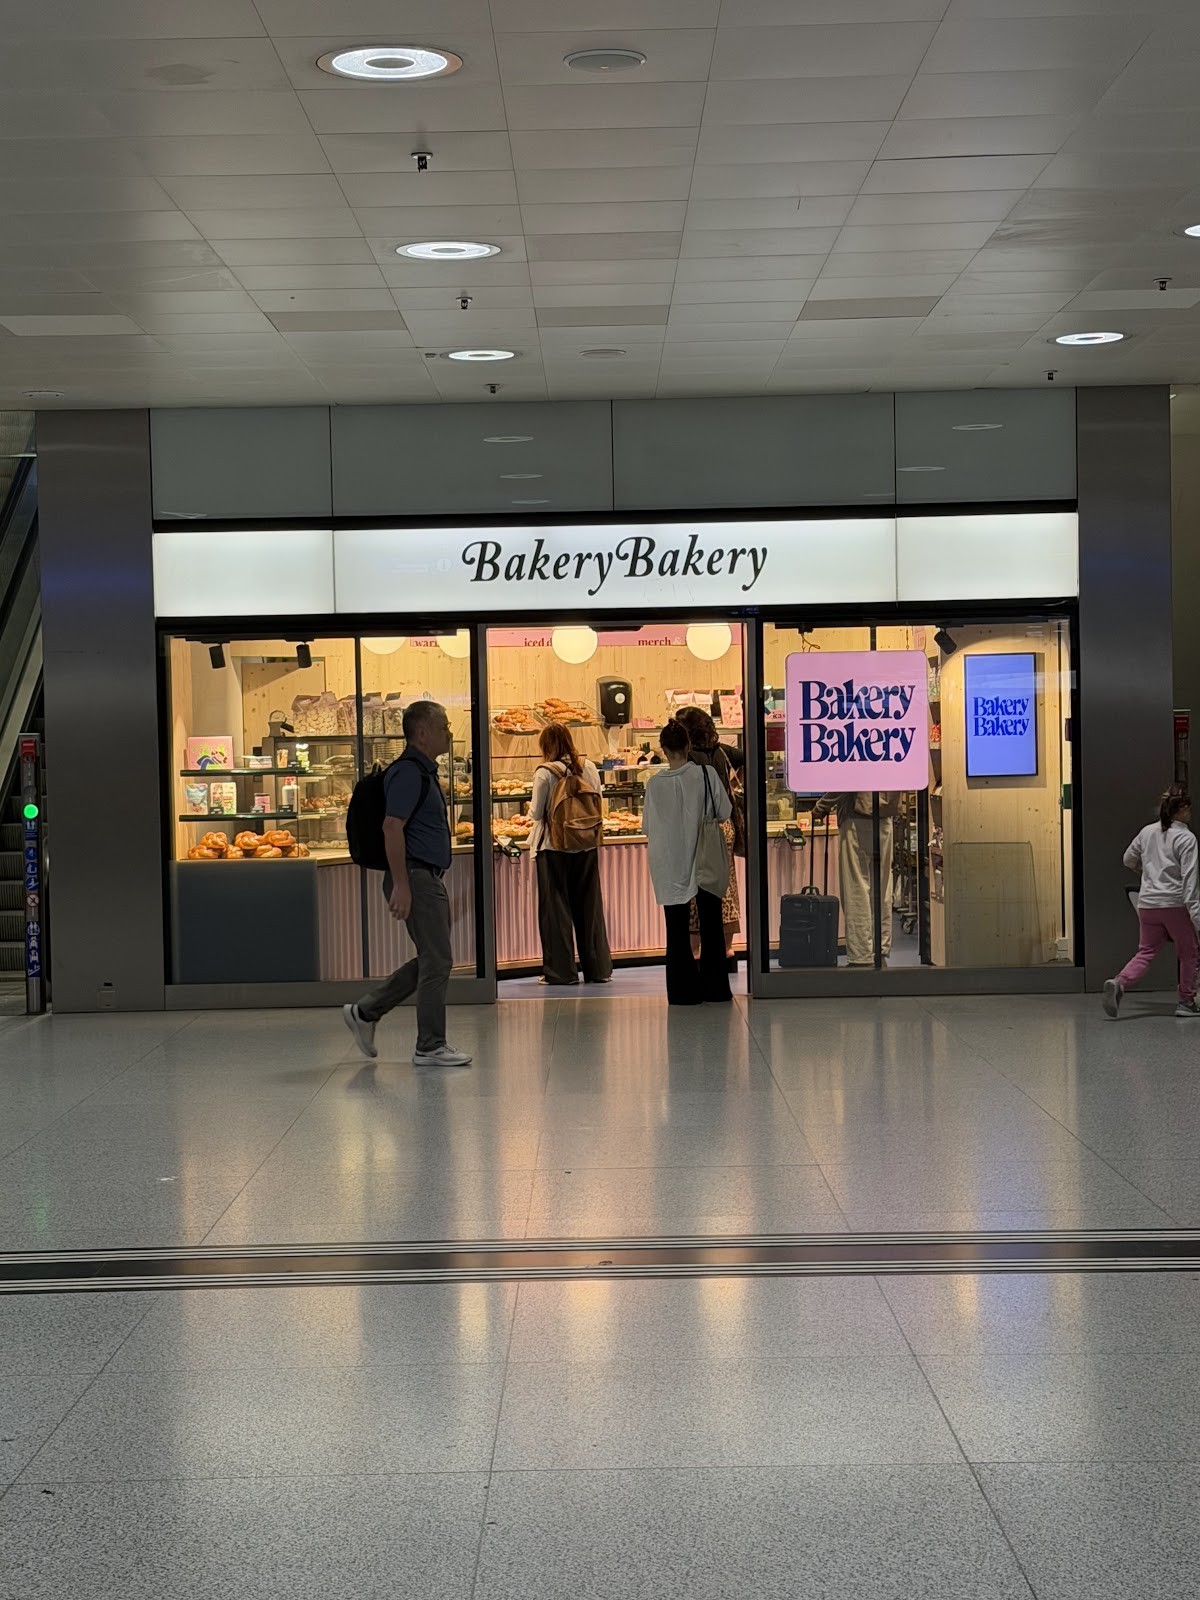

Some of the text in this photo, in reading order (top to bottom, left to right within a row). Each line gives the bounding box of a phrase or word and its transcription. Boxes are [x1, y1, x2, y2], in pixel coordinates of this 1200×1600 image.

[524, 638, 545, 647] iced
[638, 636, 671, 646] merch
[799, 679, 916, 720] Bakery
[972, 696, 1030, 717] Bakery
[973, 716, 1030, 737] Bakery
[799, 721, 917, 763] Bakery
